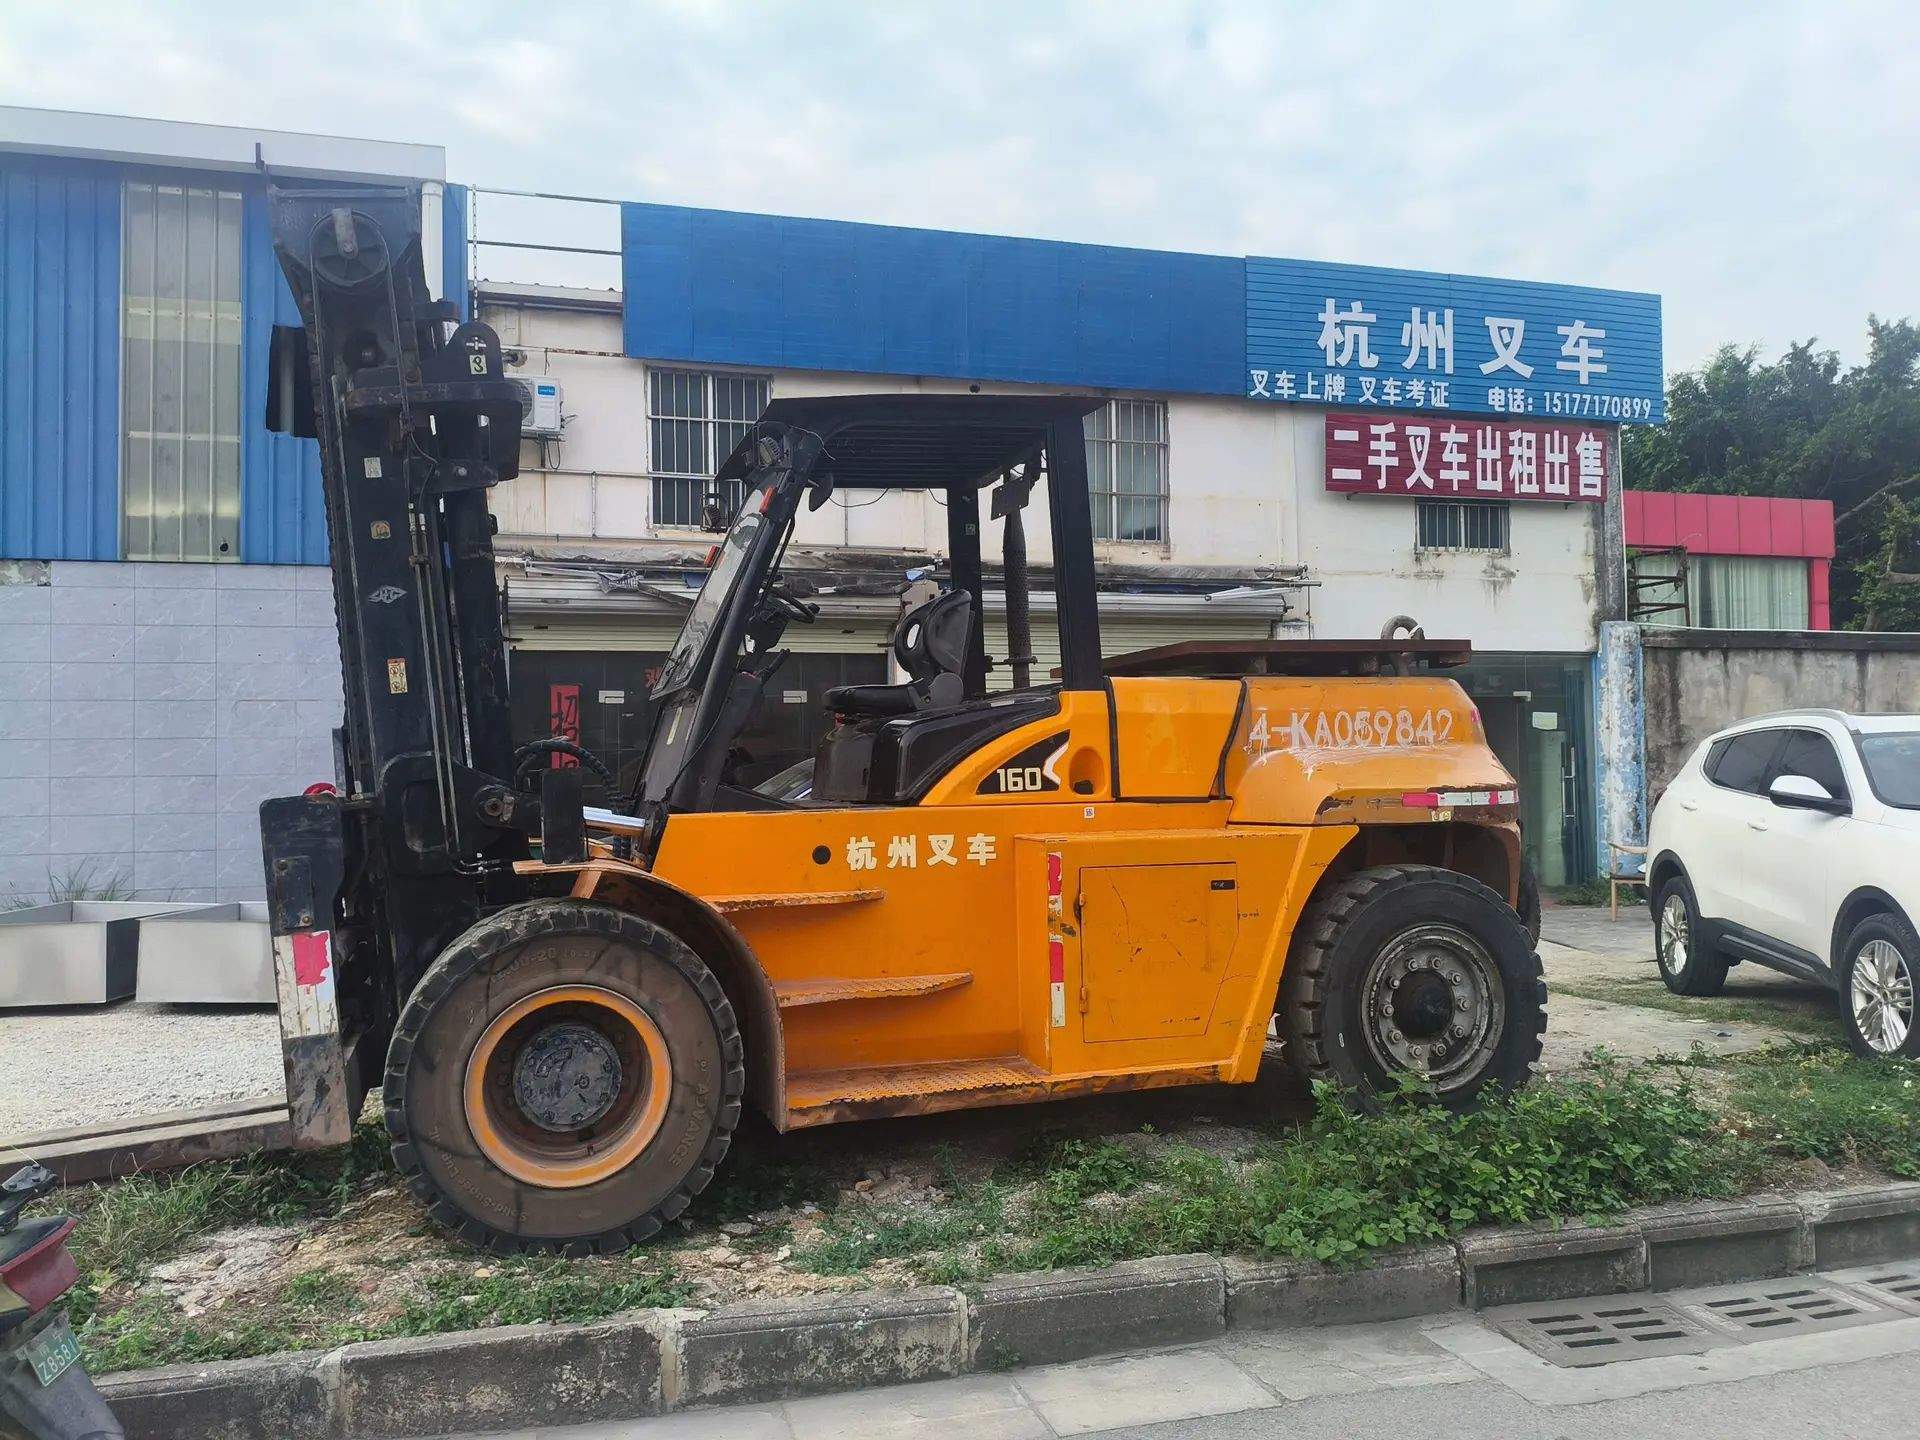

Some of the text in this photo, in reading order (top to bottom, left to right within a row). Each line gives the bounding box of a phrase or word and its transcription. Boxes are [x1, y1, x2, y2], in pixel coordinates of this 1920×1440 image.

[1317, 297, 1608, 385] 杭州叉车
[1250, 369, 1450, 408] 叉车上牌 叉车考证
[1543, 391, 1651, 420] 15177170899
[1331, 421, 1604, 498] 二手叉车出租出售
[996, 767, 1042, 792] 160
[846, 833, 997, 871] 杭州叉车
